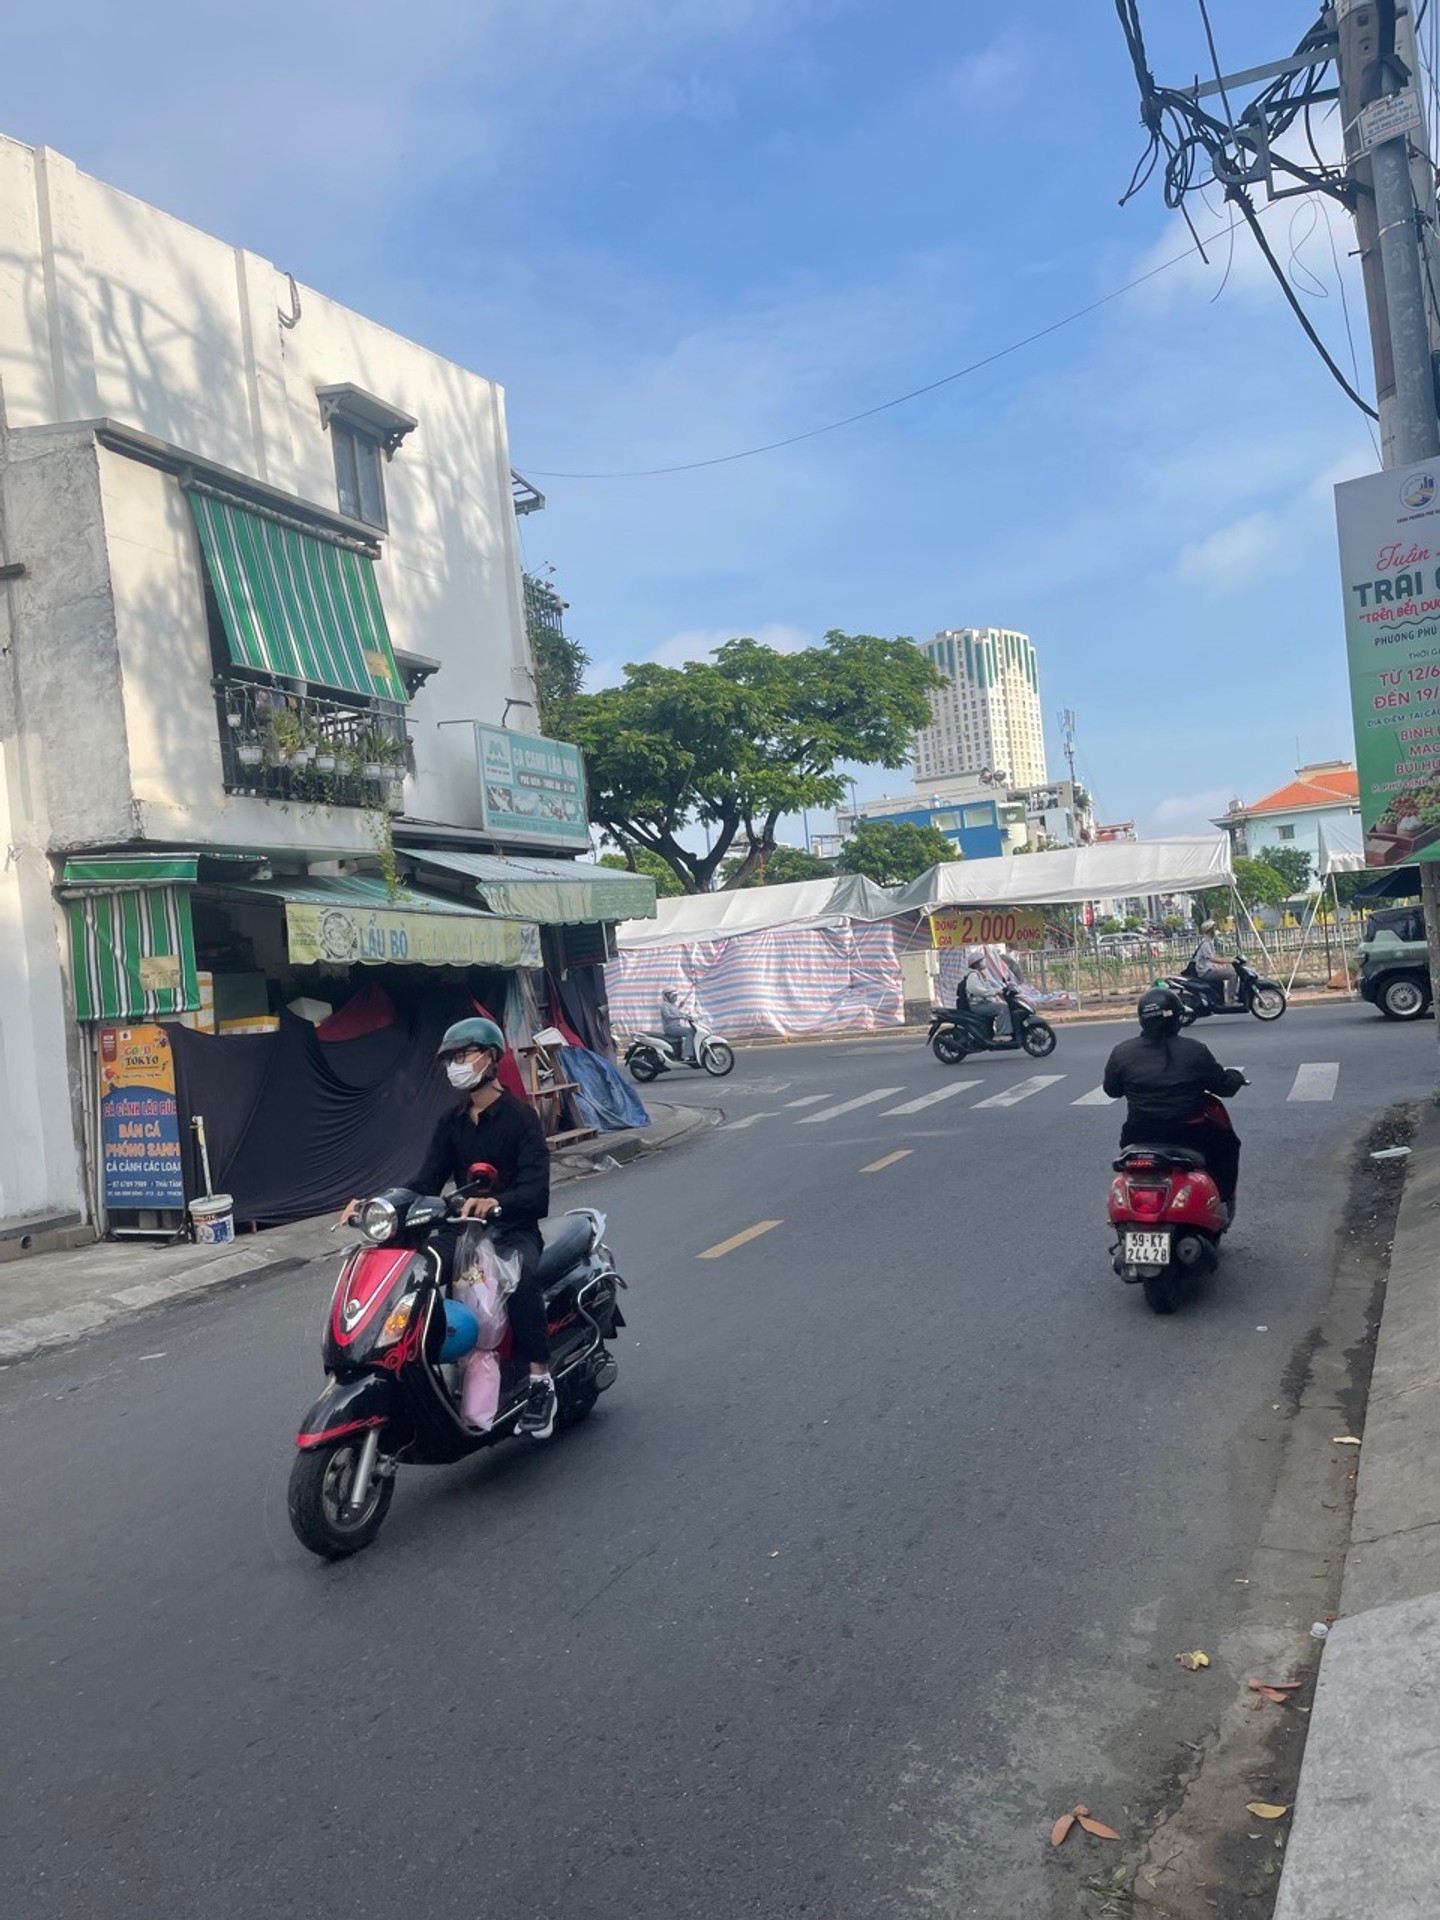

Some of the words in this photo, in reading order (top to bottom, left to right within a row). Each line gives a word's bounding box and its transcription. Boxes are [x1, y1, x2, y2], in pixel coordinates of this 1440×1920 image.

[1376, 543, 1430, 571] Tuần
[1353, 565, 1423, 607] TRÁI
[1378, 669, 1403, 687] TỪ
[1374, 689, 1411, 709] ĐẾN
[1400, 727, 1433, 742] BÌNH
[962, 914, 1015, 943] 2.000
[390, 921, 408, 959] BÒ
[125, 1055, 159, 1066] TOKYO
[119, 1120, 144, 1138] BÁN
[144, 1120, 162, 1138] CÁ
[106, 1160, 118, 1172] CÁ
[143, 1160, 160, 1172] CÁC
